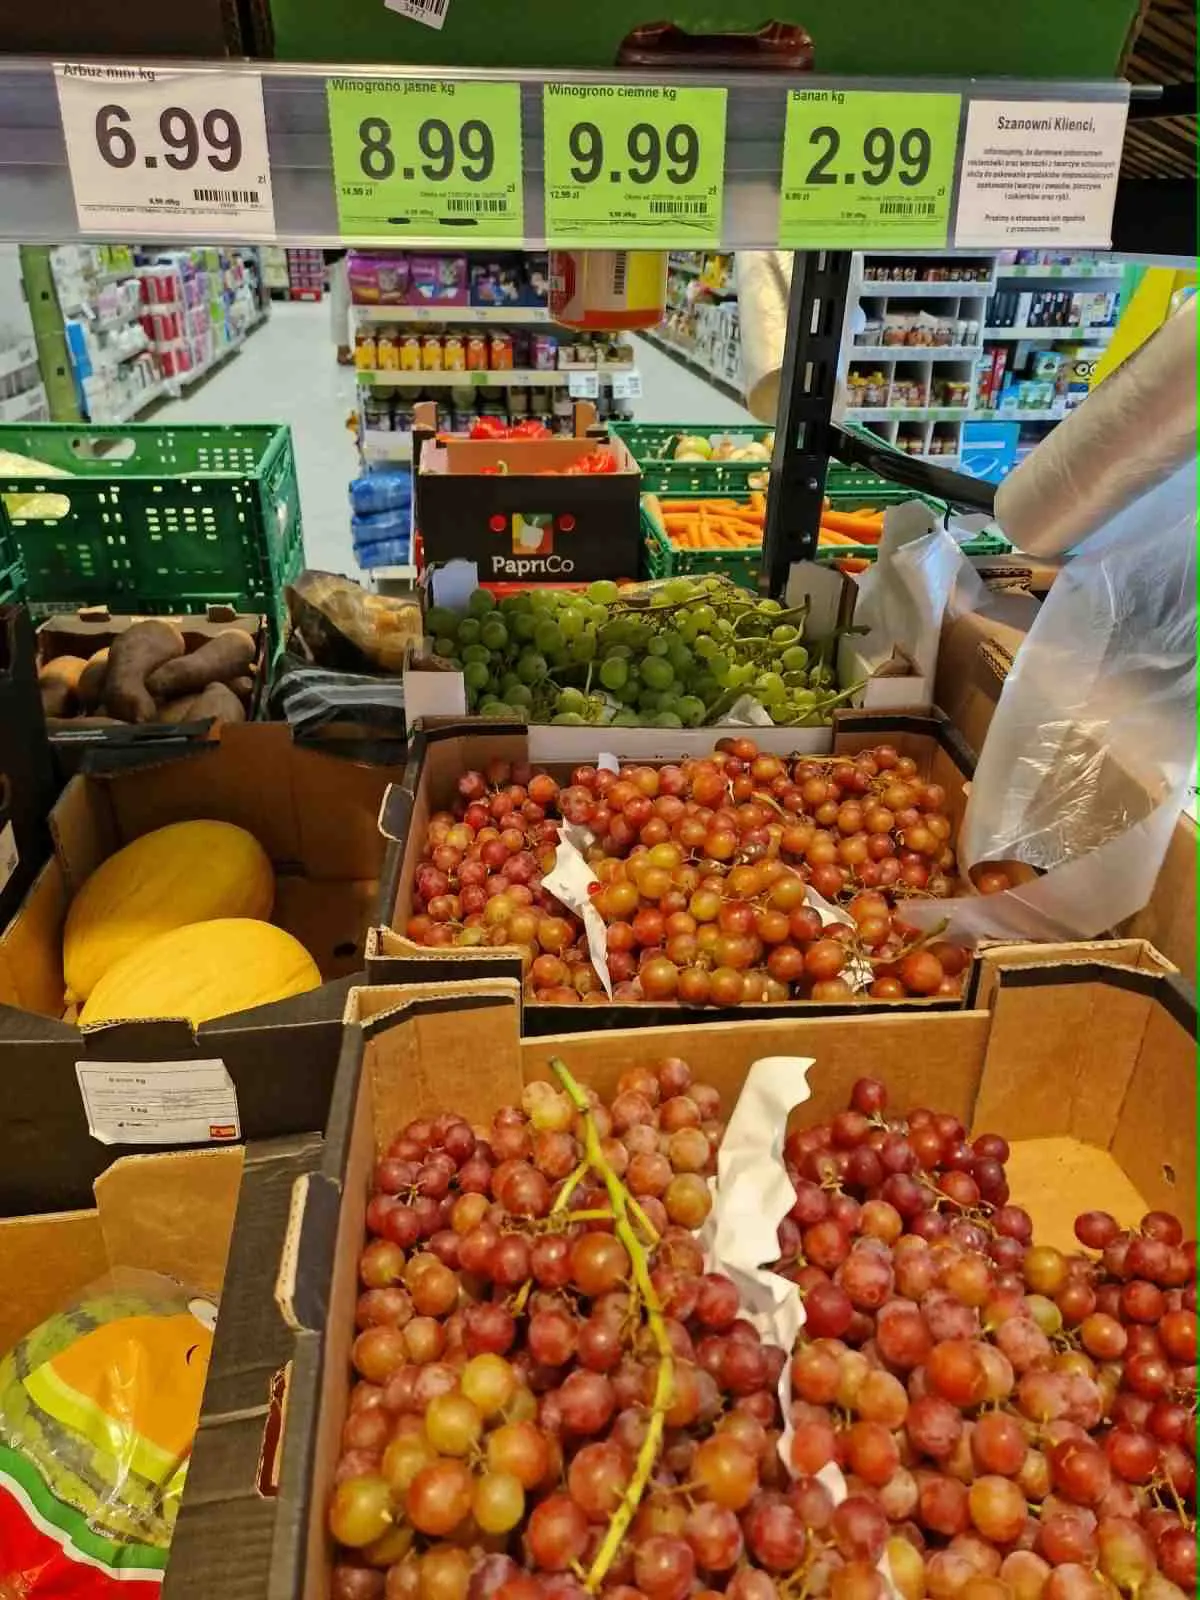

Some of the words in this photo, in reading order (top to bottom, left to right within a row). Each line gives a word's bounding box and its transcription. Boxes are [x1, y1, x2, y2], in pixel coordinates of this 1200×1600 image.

[63, 64, 102, 77] Arbuz
[106, 67, 135, 79] mini
[138, 67, 156, 82] kg
[332, 80, 401, 94] Winogrono
[404, 81, 437, 95] jasne
[440, 82, 455, 96] kg
[548, 84, 614, 99] Winogrono
[618, 86, 659, 98] ciemne
[663, 87, 677, 101] kg
[793, 89, 828, 101] Banan
[832, 89, 845, 104] kg
[997, 116, 1052, 130] Szanowni
[1054, 117, 1096, 133] Klienci,
[95, 104, 242, 172] 6.99
[359, 117, 495, 182] 8.99
[569, 122, 699, 185] 9.99
[805, 126, 931, 186] 2.99
[491, 556, 575, 577] PapriCo
